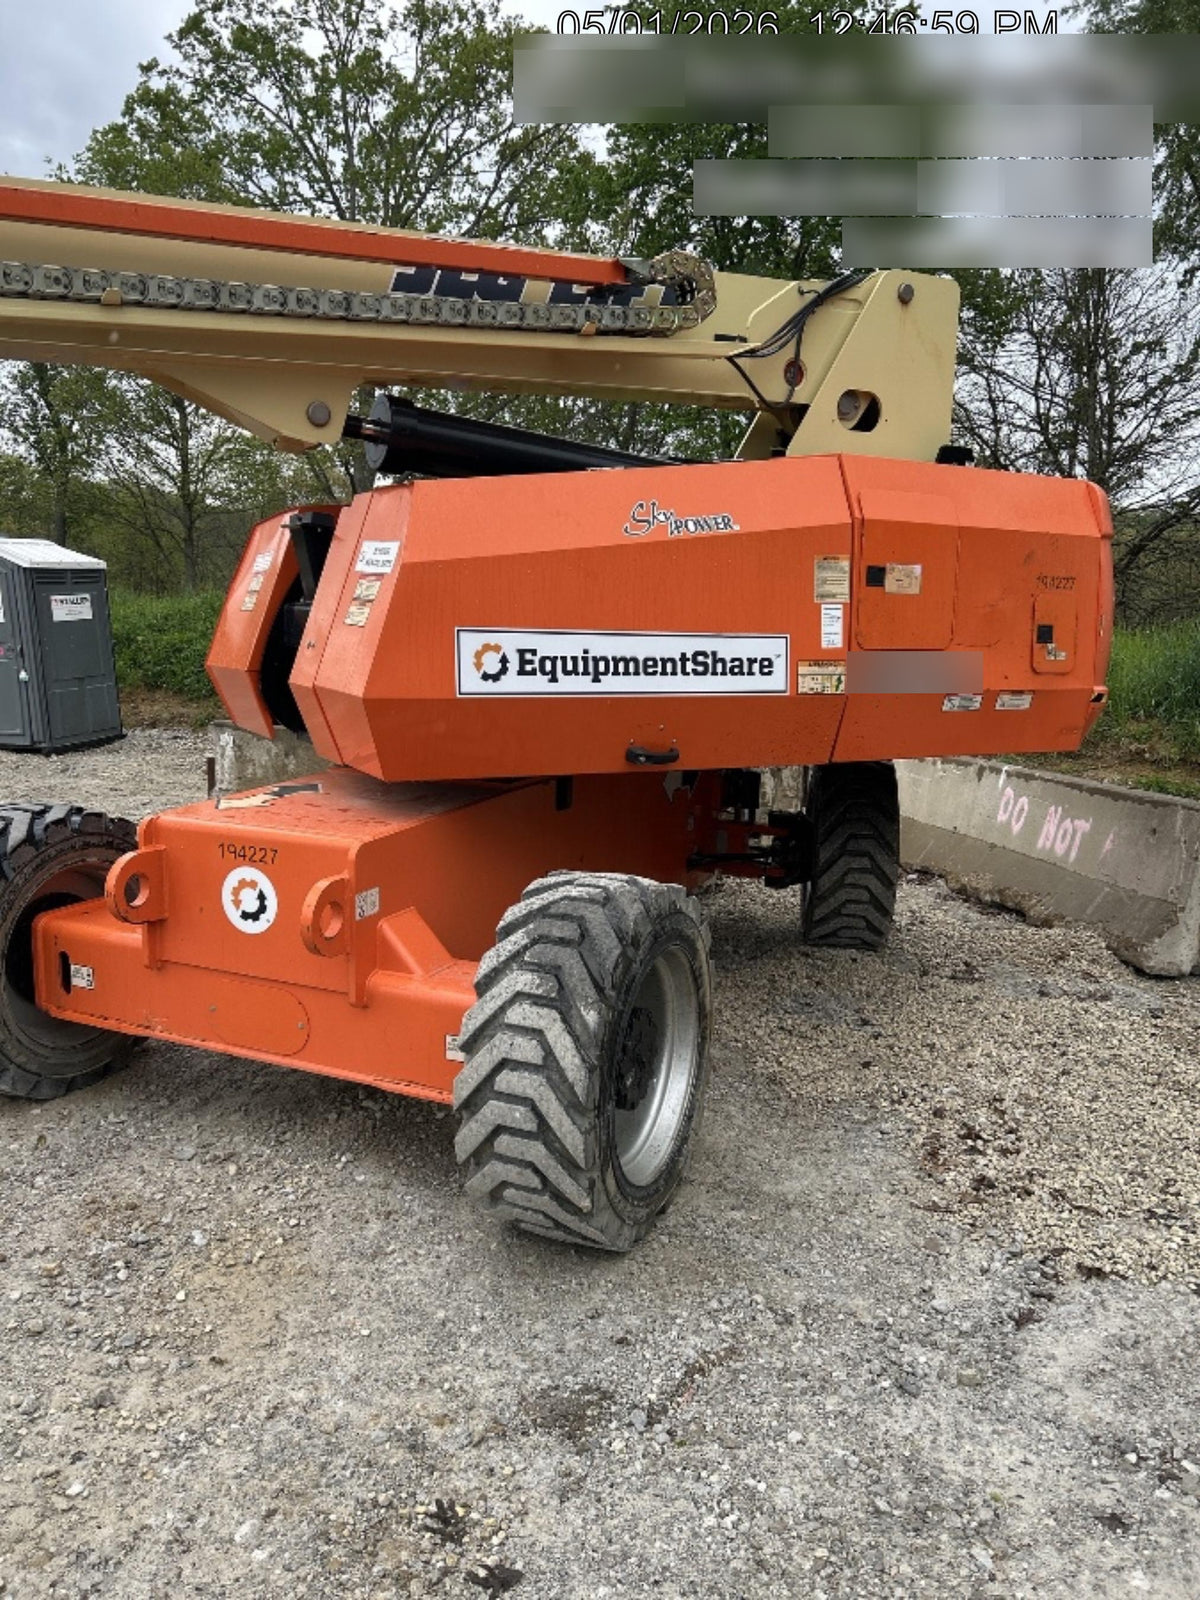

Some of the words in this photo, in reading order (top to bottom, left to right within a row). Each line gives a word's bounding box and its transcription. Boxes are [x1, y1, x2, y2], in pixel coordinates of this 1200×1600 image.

[516, 648, 774, 683] EquipmentShare
[997, 786, 1029, 836] DO
[1036, 804, 1093, 864] NOT
[218, 842, 278, 864] 194227
